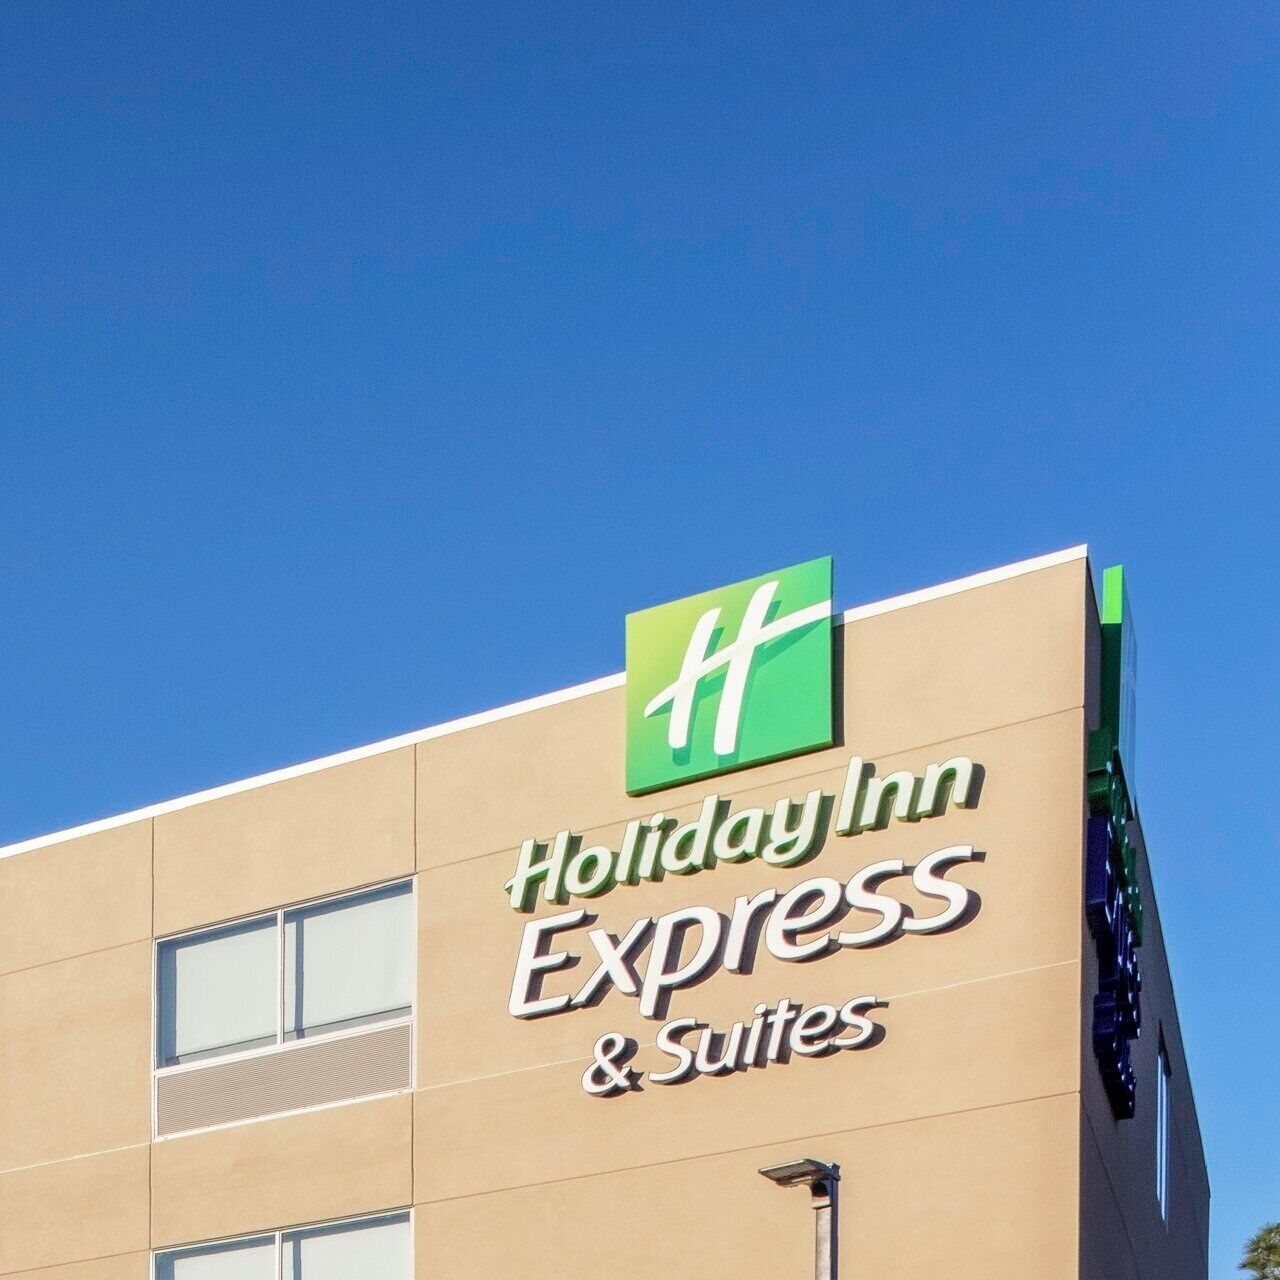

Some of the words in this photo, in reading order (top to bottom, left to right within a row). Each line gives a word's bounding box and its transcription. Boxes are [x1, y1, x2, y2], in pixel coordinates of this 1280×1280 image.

[504, 788, 823, 912] Holiday
[835, 756, 974, 837] Inn
[508, 845, 975, 1020] Express
[581, 1031, 634, 1096] &
[648, 996, 878, 1084] Suites
